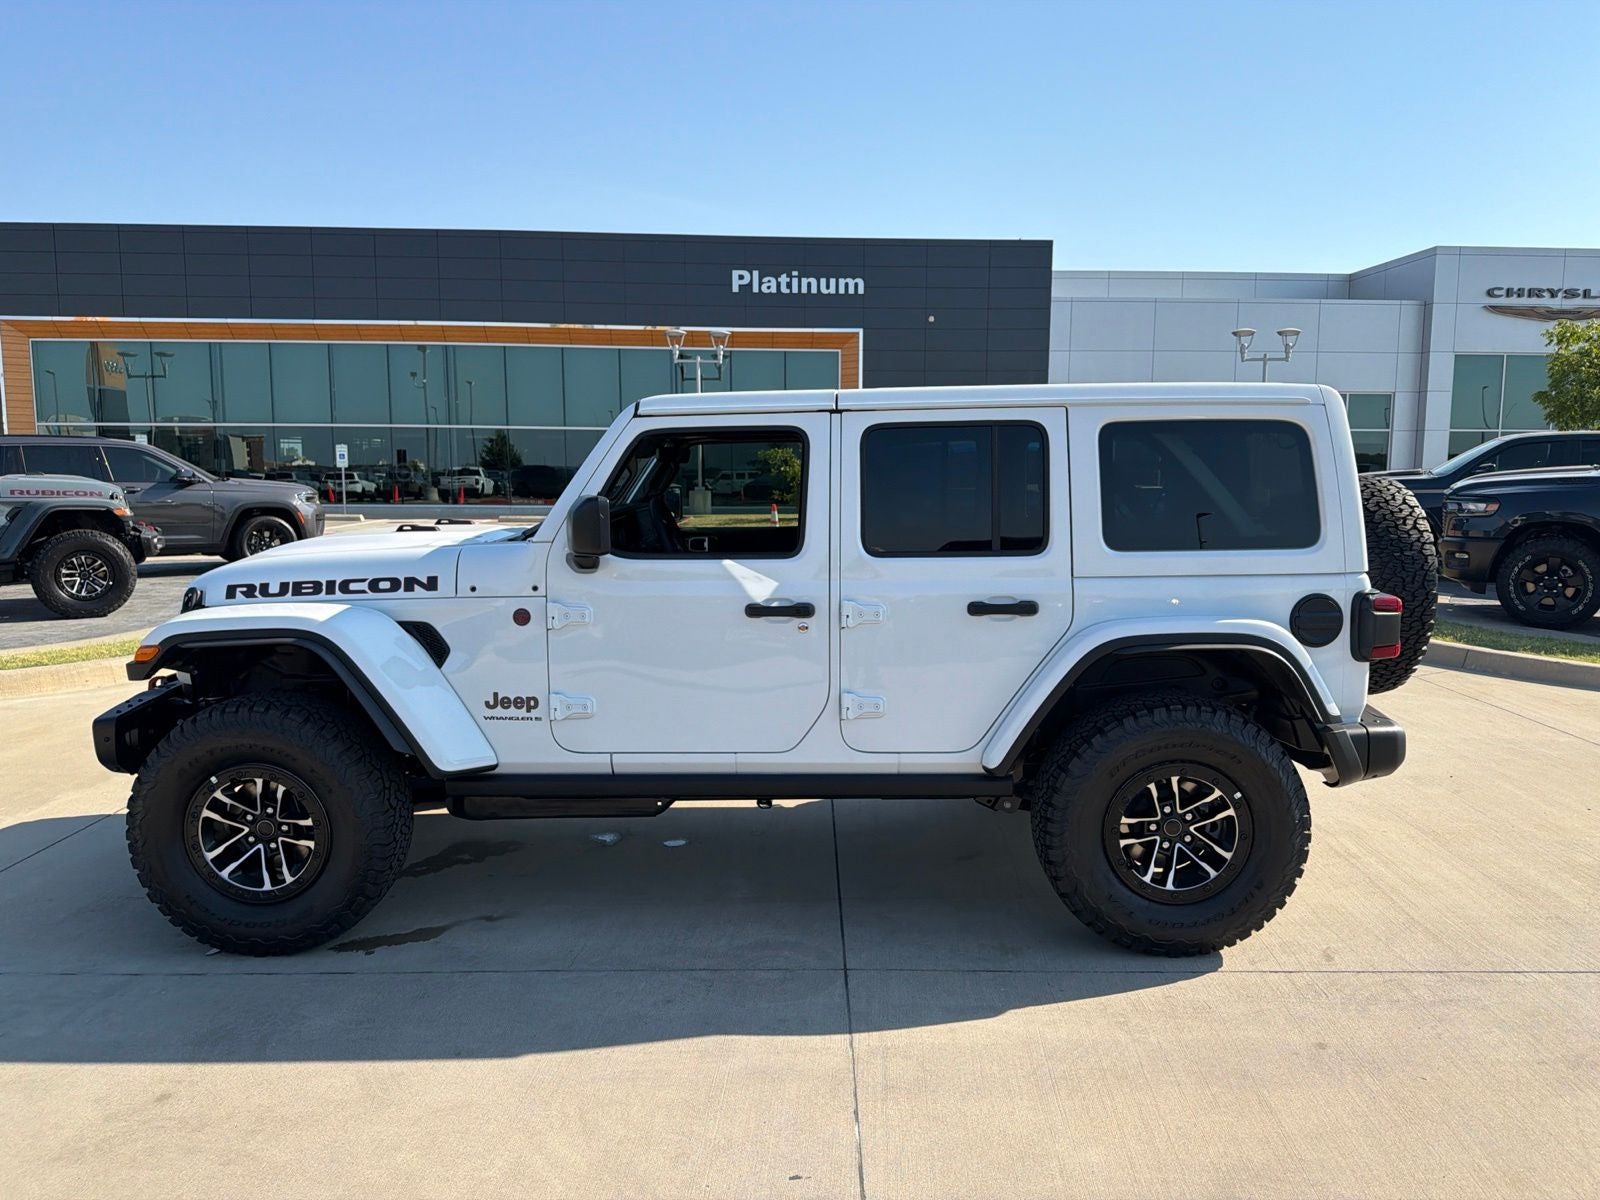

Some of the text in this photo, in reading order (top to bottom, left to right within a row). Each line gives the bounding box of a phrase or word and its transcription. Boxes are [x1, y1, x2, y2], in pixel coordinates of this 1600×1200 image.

[732, 270, 865, 294] Platinum
[9, 489, 104, 497] RUBICON
[225, 575, 438, 600] RUBICON
[484, 692, 539, 713] Jeep
